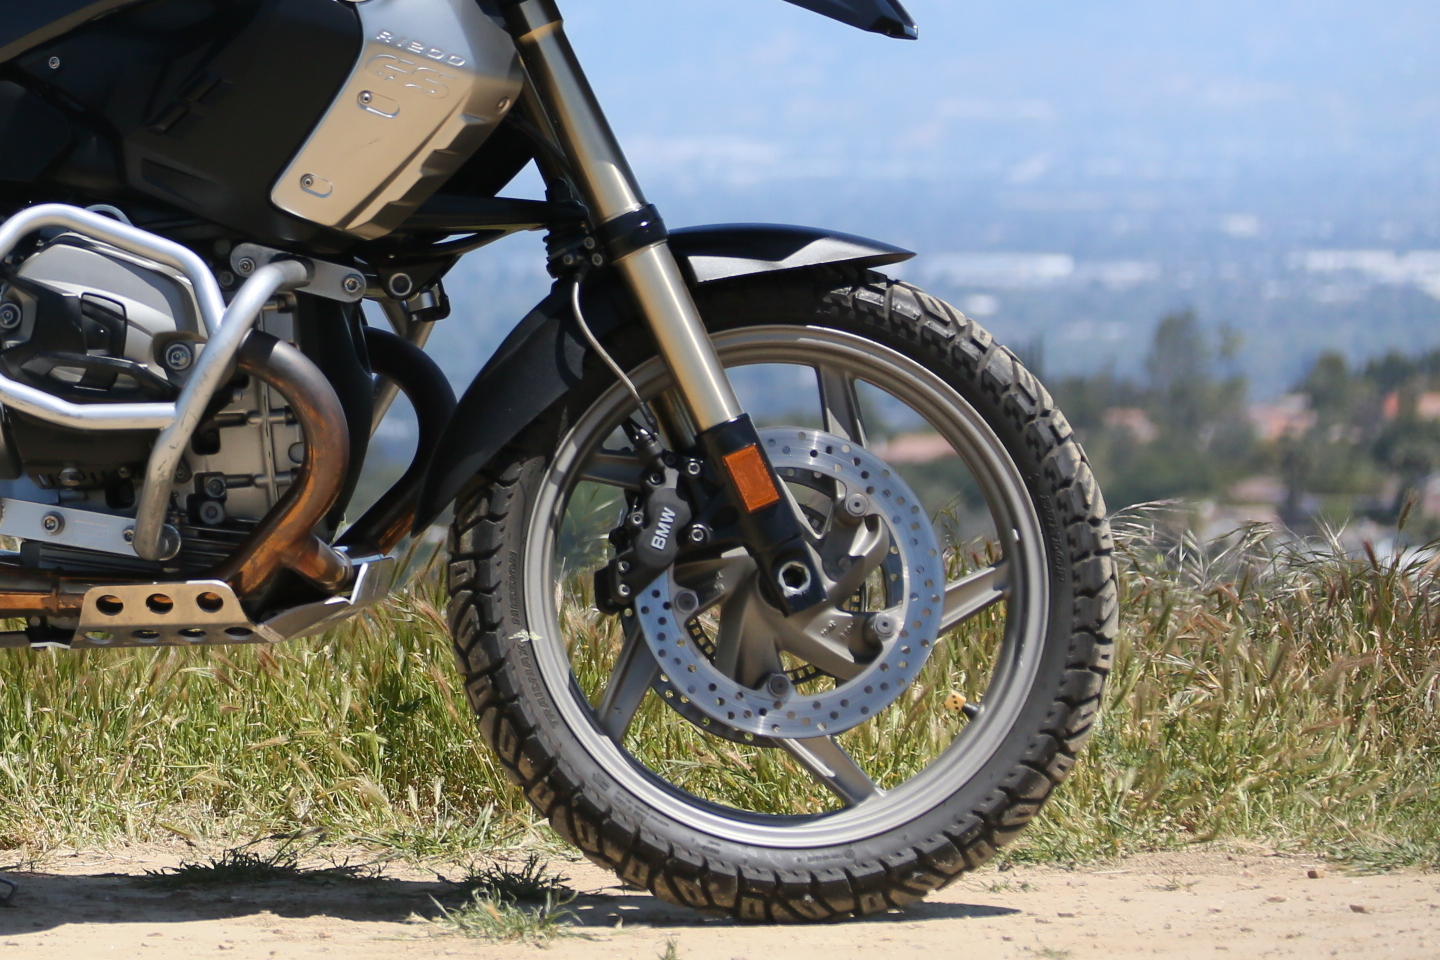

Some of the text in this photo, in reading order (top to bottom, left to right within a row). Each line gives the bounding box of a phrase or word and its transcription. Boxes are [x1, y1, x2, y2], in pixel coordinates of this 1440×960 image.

[376, 30, 466, 67] R1200
[365, 54, 457, 99] GS
[651, 506, 676, 551] BMW
